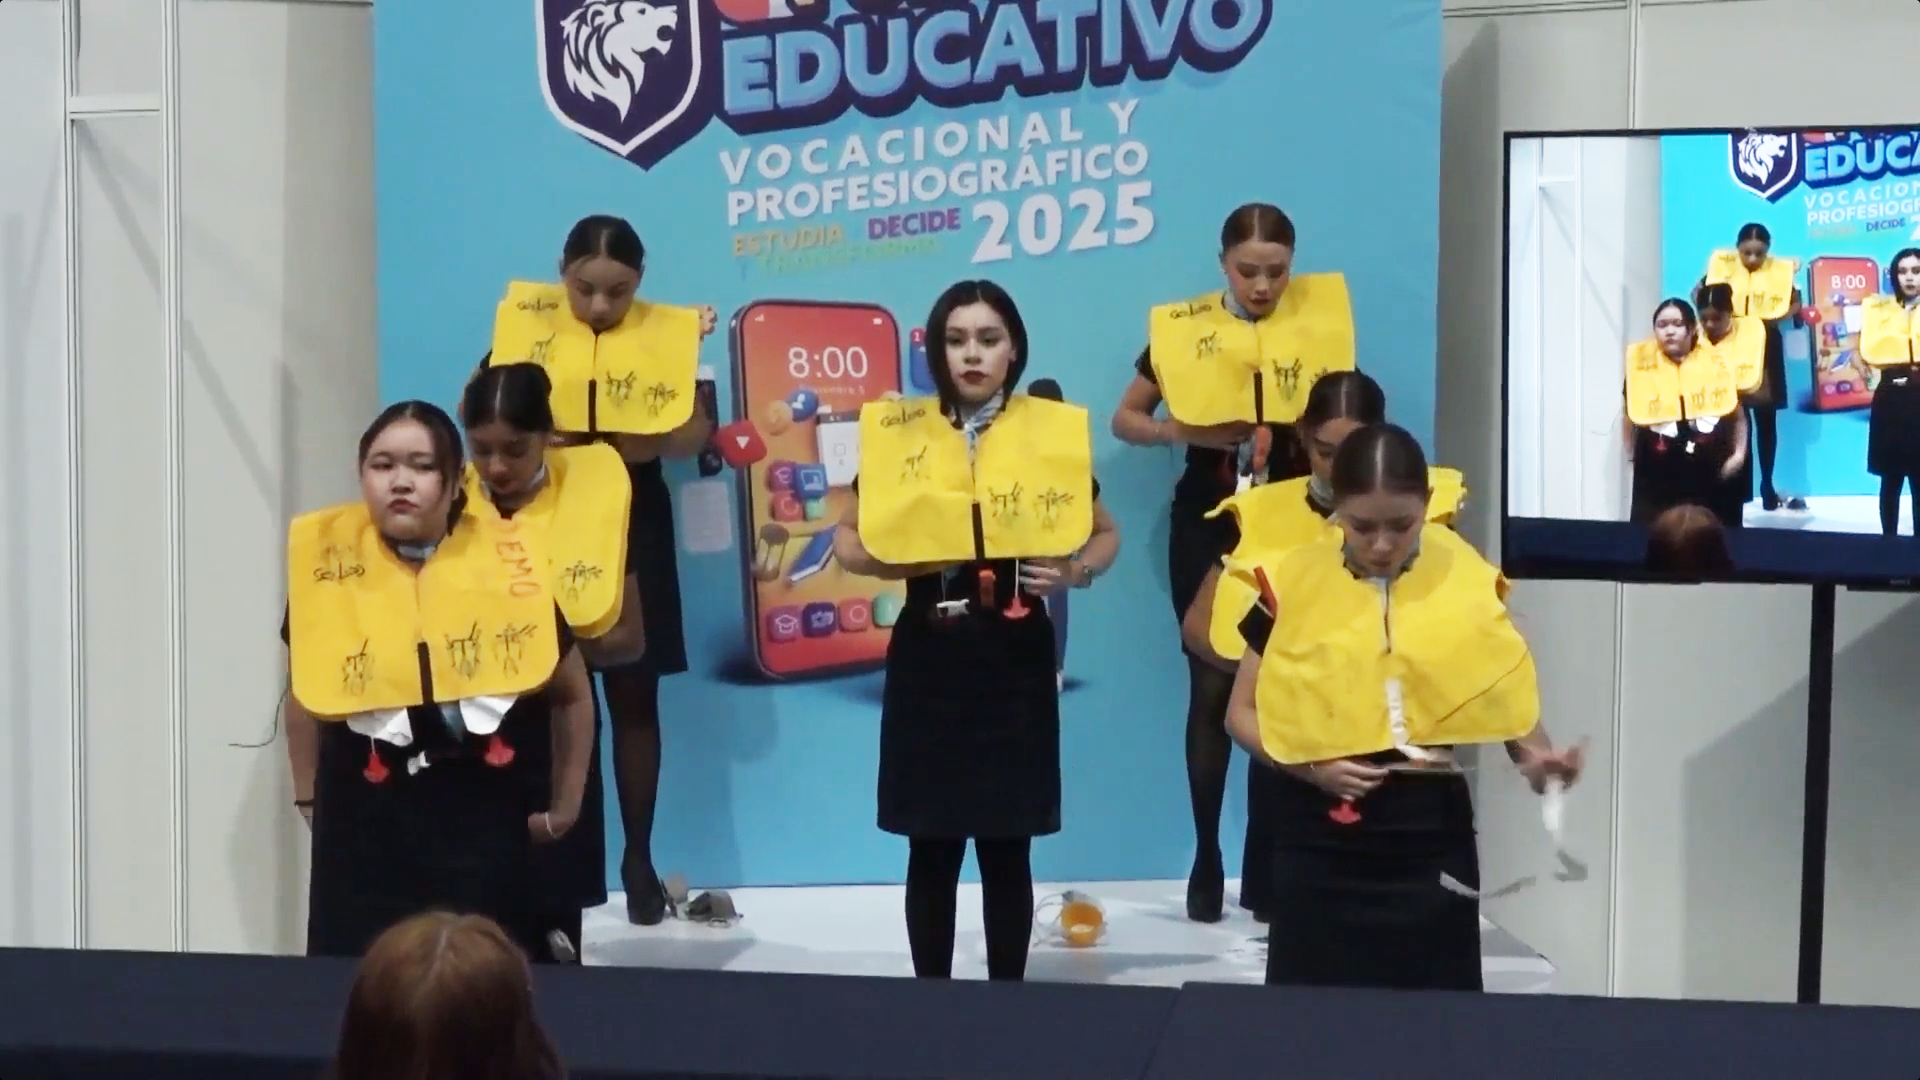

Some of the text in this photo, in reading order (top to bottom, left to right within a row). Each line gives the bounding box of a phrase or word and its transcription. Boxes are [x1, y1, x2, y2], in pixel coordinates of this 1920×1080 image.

[722, 0, 1263, 116] EDUCATIVO
[719, 99, 1140, 185] VOCACIONAL Y
[728, 141, 1149, 227] PROFESIOGRÁFICO
[733, 181, 1155, 264] ESTUDIA DECIDE 2025
[1866, 217, 1906, 233] DECIDE
[1831, 274, 1867, 289] 8:00
[788, 346, 868, 378] 8:00
